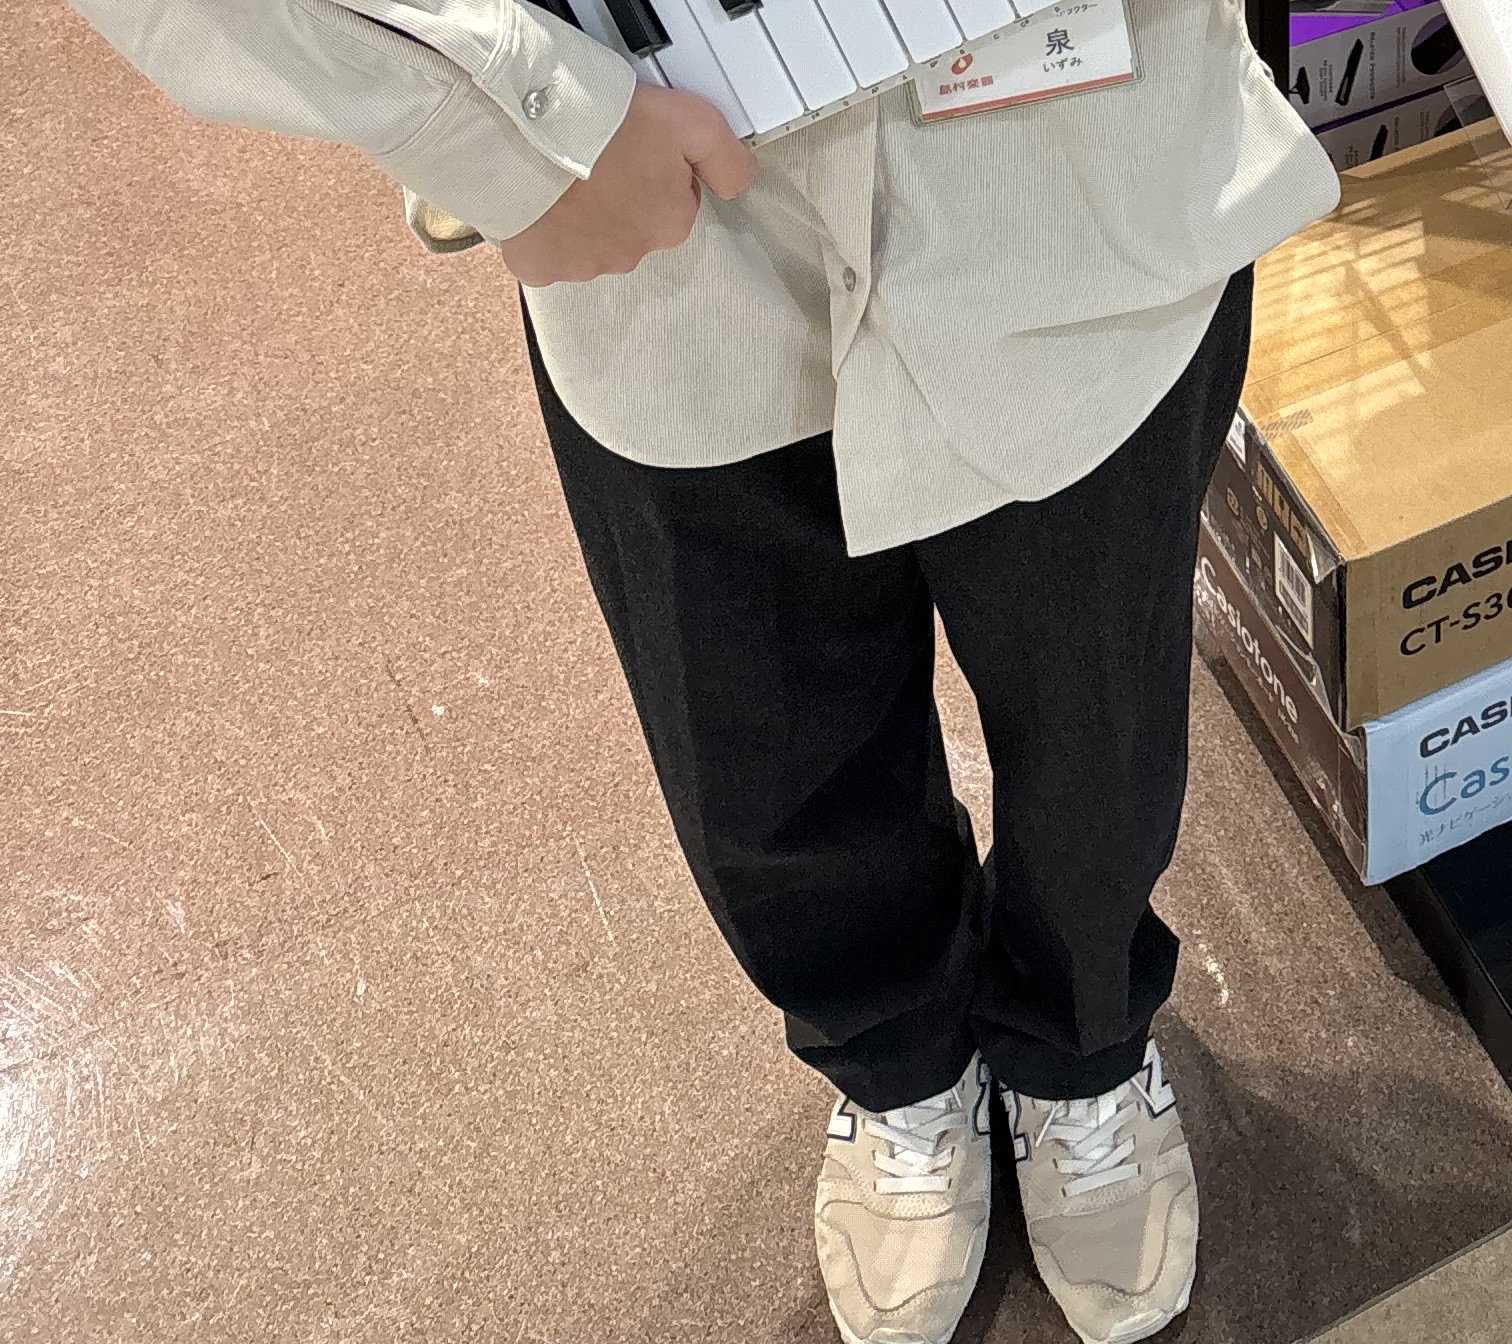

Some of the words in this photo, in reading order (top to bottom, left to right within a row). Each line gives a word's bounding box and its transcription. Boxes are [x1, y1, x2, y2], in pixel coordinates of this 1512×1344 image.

[1045, 27, 1075, 57] 泉
[1043, 57, 1083, 74] いずみ
[1201, 556, 1299, 724] Casiotone
